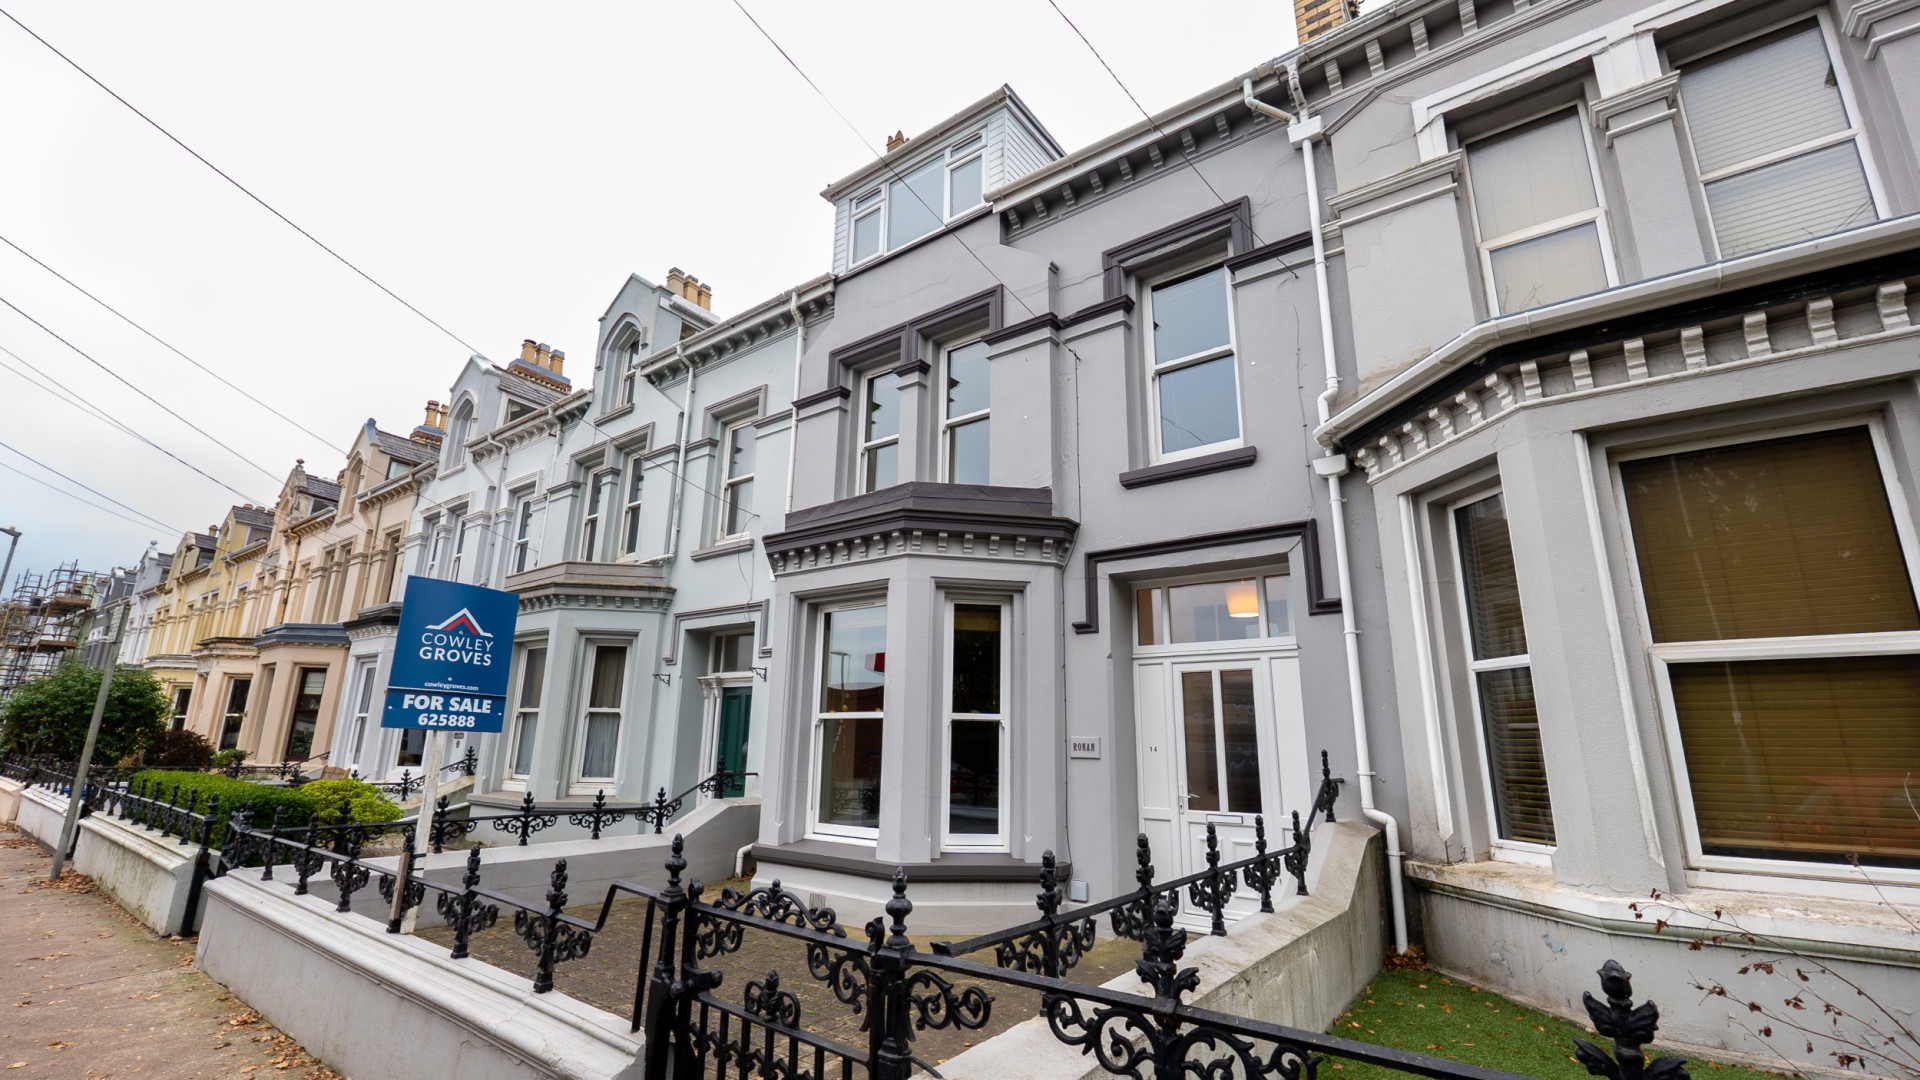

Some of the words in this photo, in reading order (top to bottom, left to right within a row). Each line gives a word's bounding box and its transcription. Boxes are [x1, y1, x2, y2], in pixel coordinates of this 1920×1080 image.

[422, 632, 494, 652] COWLEY
[419, 646, 492, 666] GROVES
[424, 682, 479, 691] cowleygroves.com
[403, 695, 444, 711] FOR
[449, 697, 492, 714] SALE
[418, 713, 476, 728] 625888
